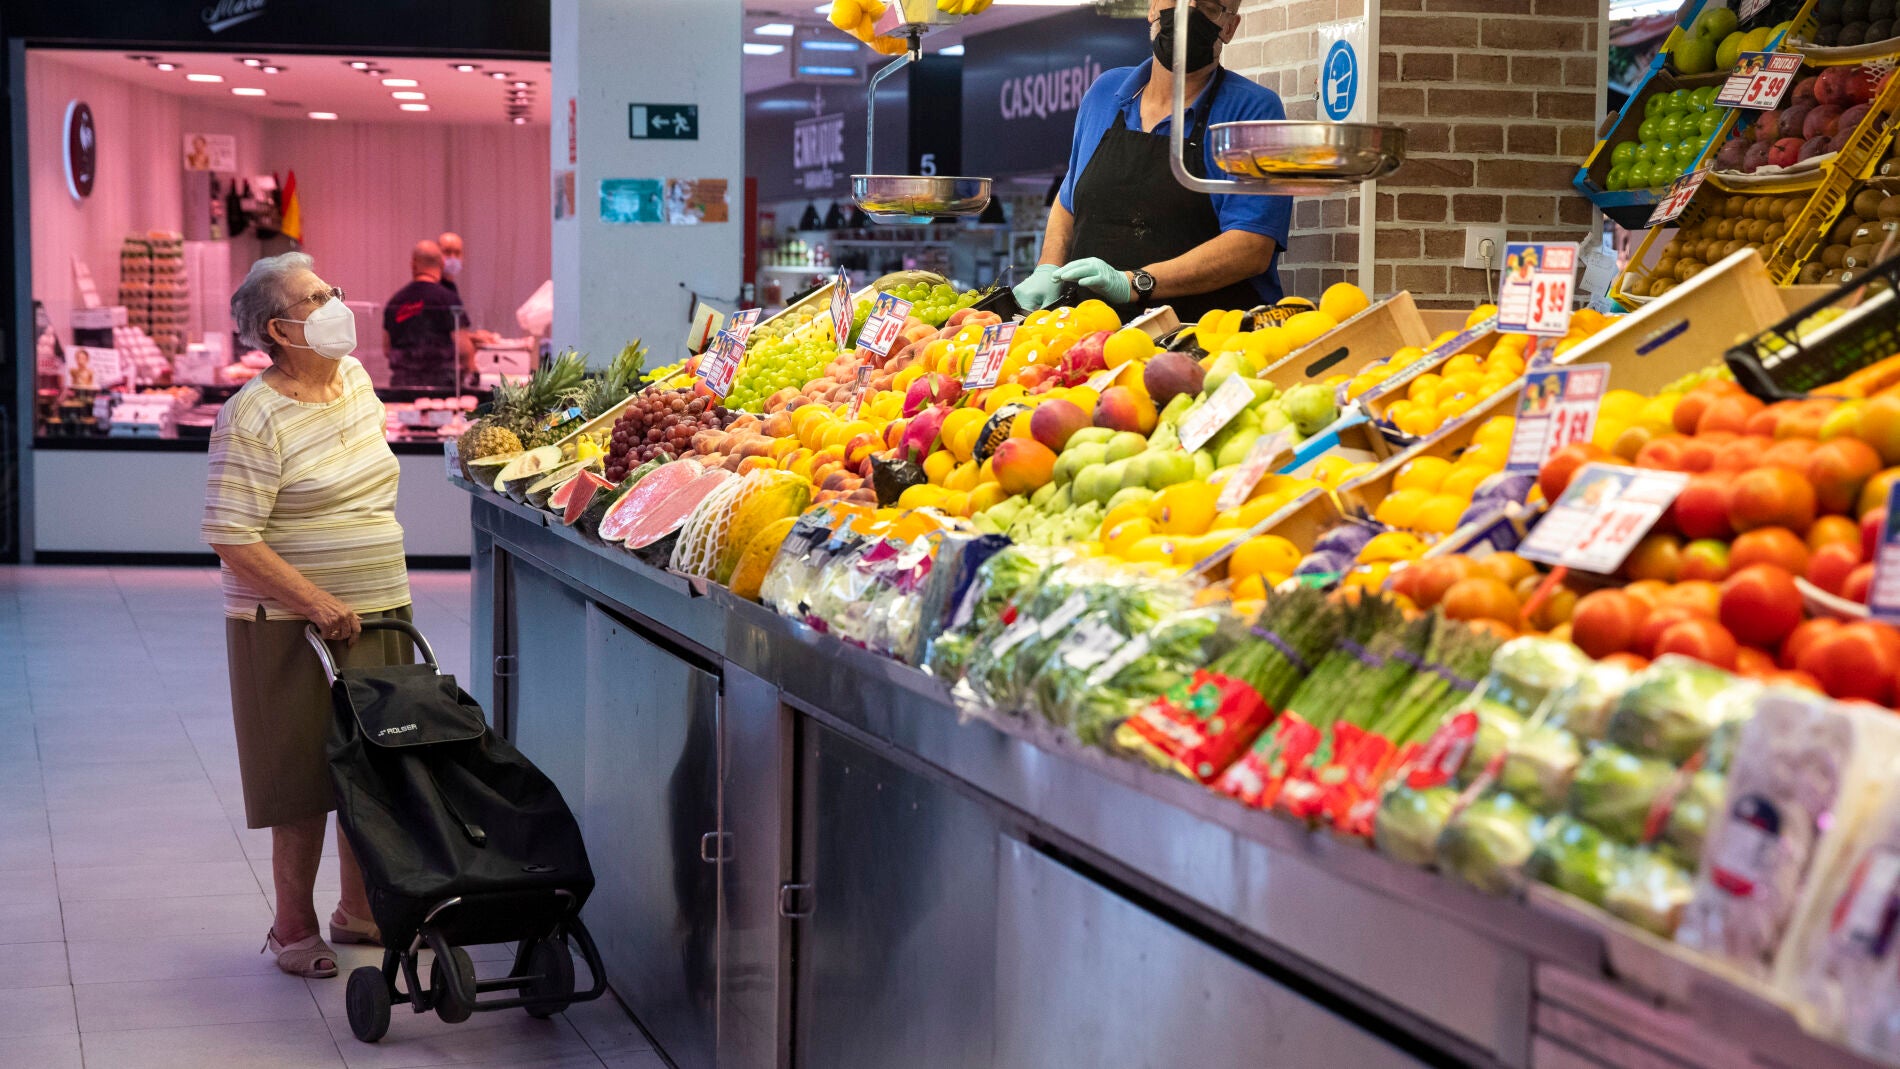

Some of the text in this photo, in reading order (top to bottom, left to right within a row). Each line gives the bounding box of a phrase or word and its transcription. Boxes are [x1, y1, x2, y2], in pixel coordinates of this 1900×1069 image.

[1770, 56, 1797, 70] FRUTAS
[919, 153, 937, 176] 5
[386, 723, 418, 734] ROLSER
